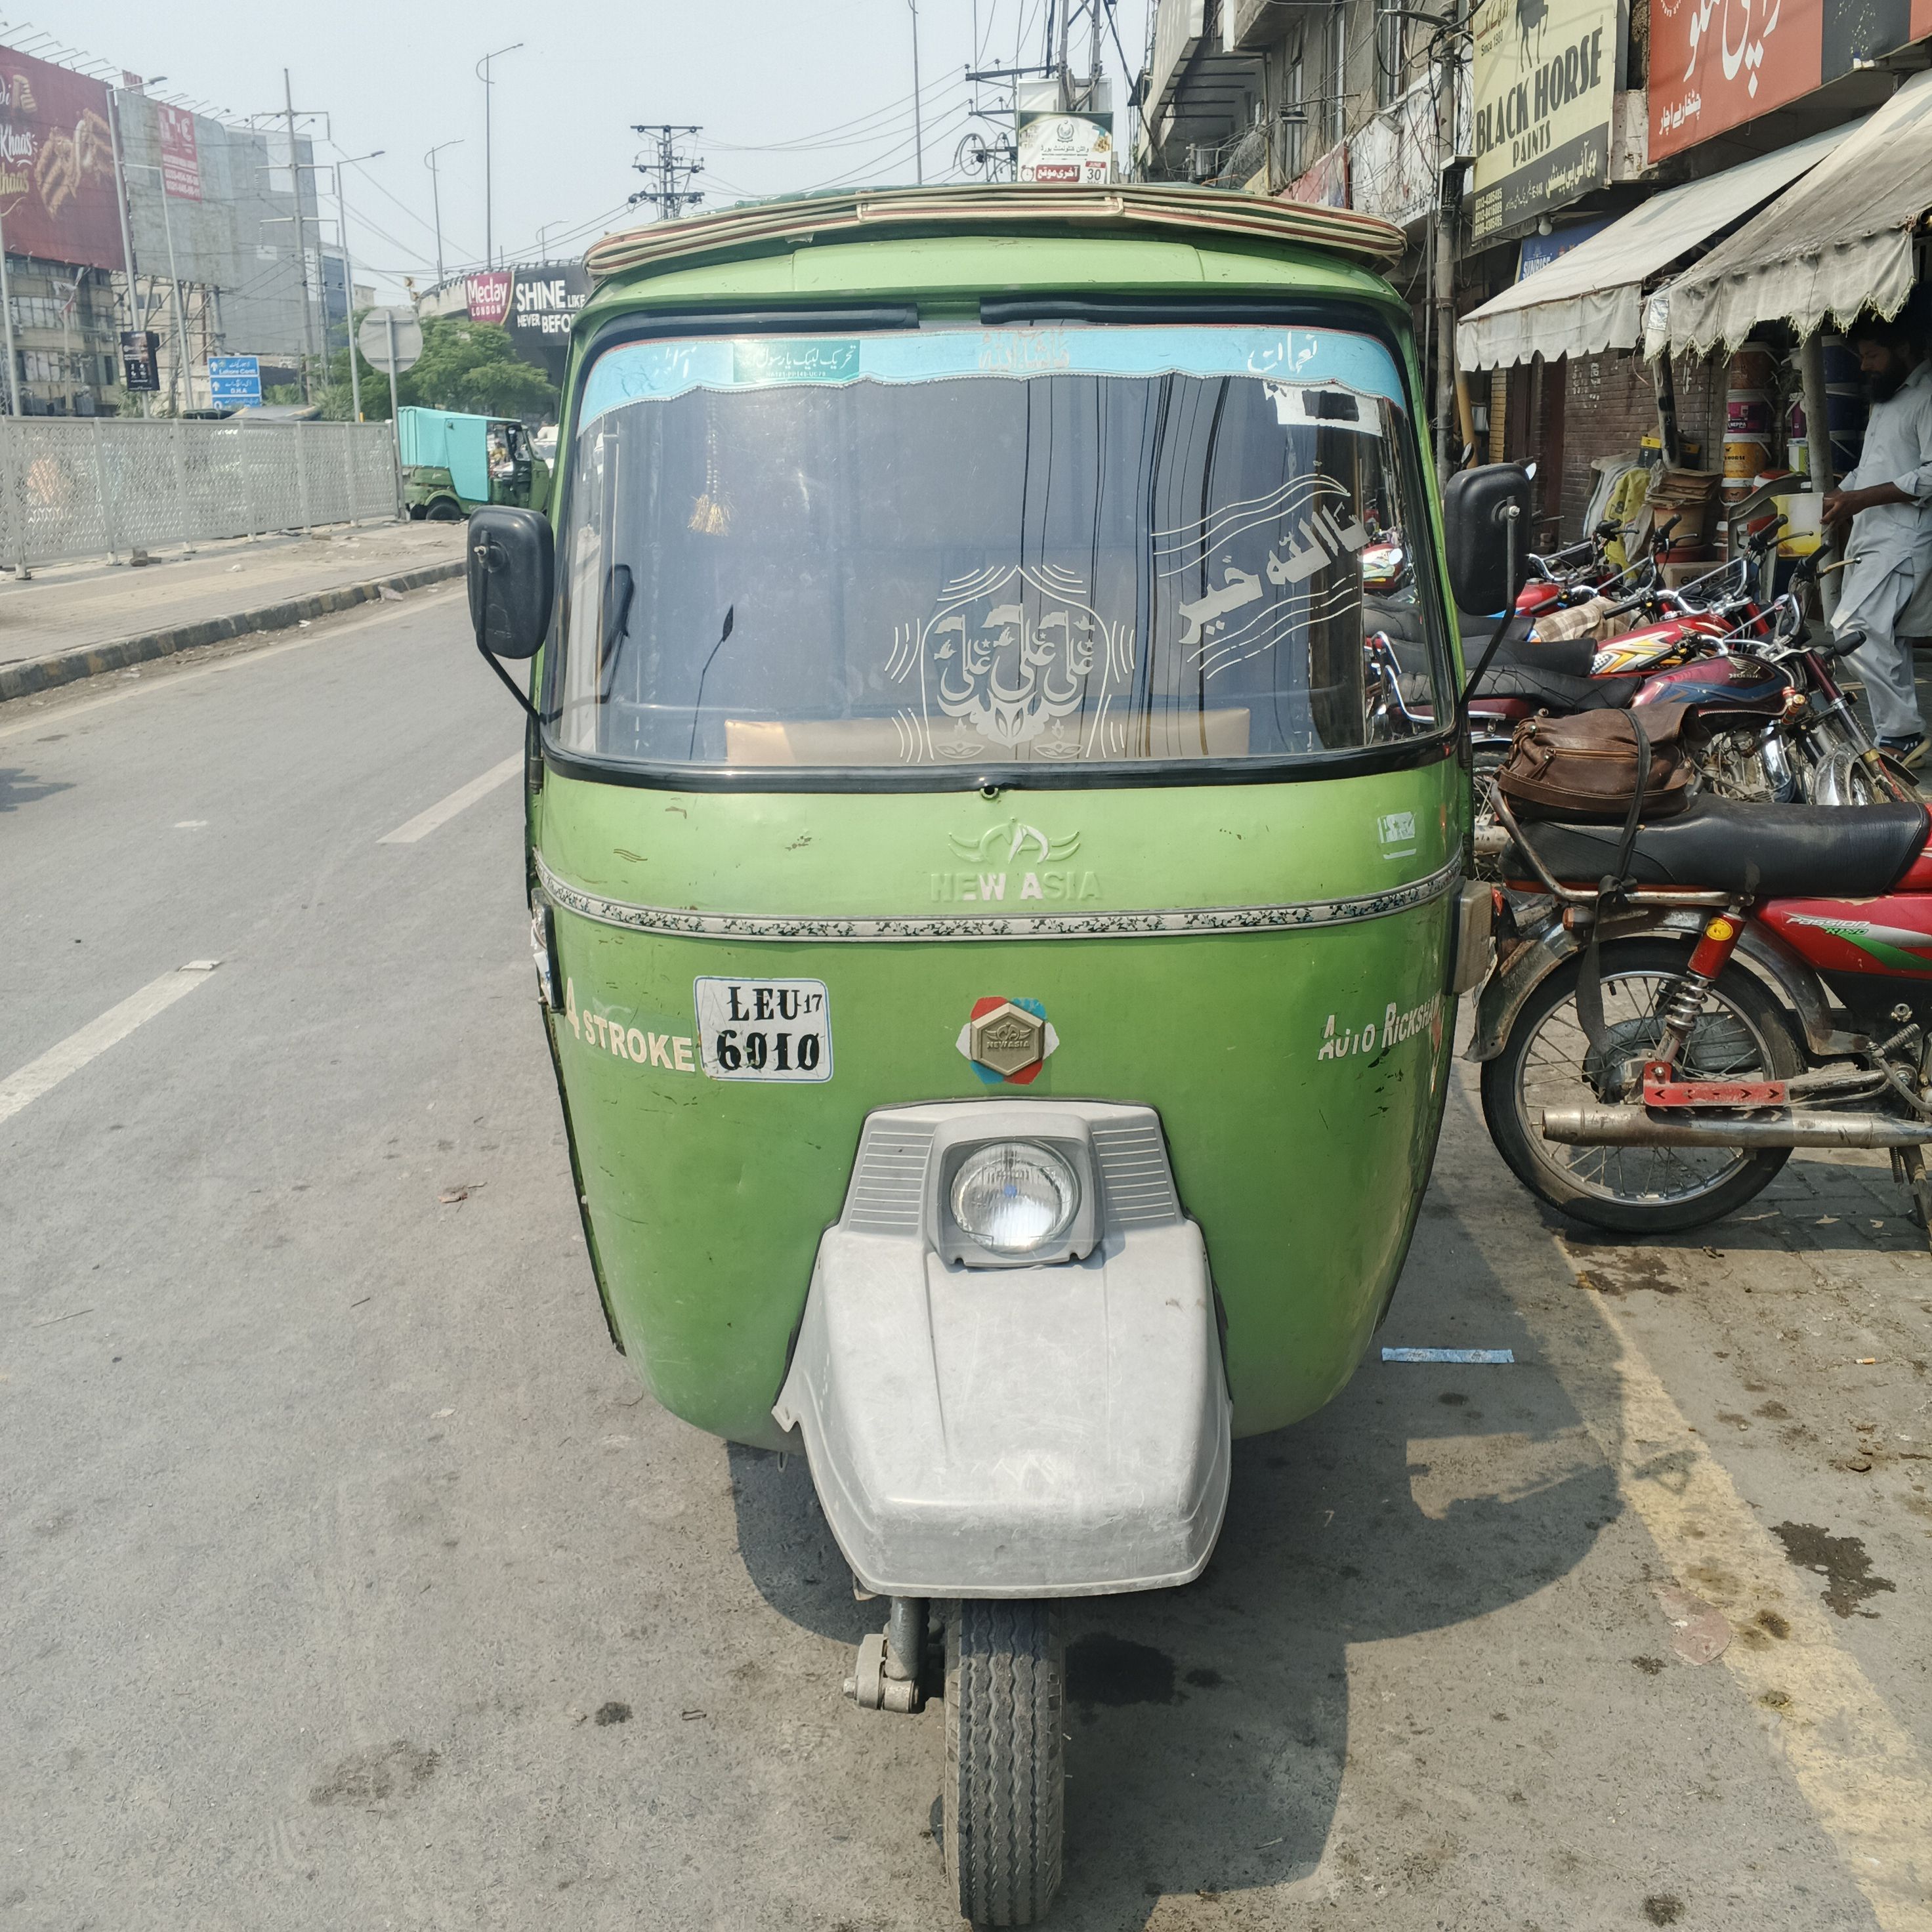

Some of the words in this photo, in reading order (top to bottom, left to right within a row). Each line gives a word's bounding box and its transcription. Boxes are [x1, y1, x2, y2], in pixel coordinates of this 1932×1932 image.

[1476, 77, 1531, 158] BLACK
[1534, 26, 1603, 118] HORSE
[1513, 127, 1551, 168] PAINTS
[1086, 168, 1102, 180] 30
[467, 278, 508, 306] Meclay
[516, 280, 566, 312] SHINE
[567, 294, 585, 308] LIKE
[471, 304, 502, 316] LONDON
[517, 314, 541, 327] NEVER
[541, 314, 575, 333] BEFO
[820, 345, 856, 369] تحریک
[1179, 555, 1263, 644] خیر
[931, 872, 1007, 902] NEW
[1019, 872, 1103, 901] ASIA
[726, 986, 801, 1022] LEU
[804, 994, 823, 1015] 17
[566, 976, 580, 1040] 4
[583, 1009, 696, 1073] STROKE
[717, 1029, 820, 1072] 6010
[987, 1041, 1007, 1049] NEW
[1007, 1040, 1030, 1049] ASIA
